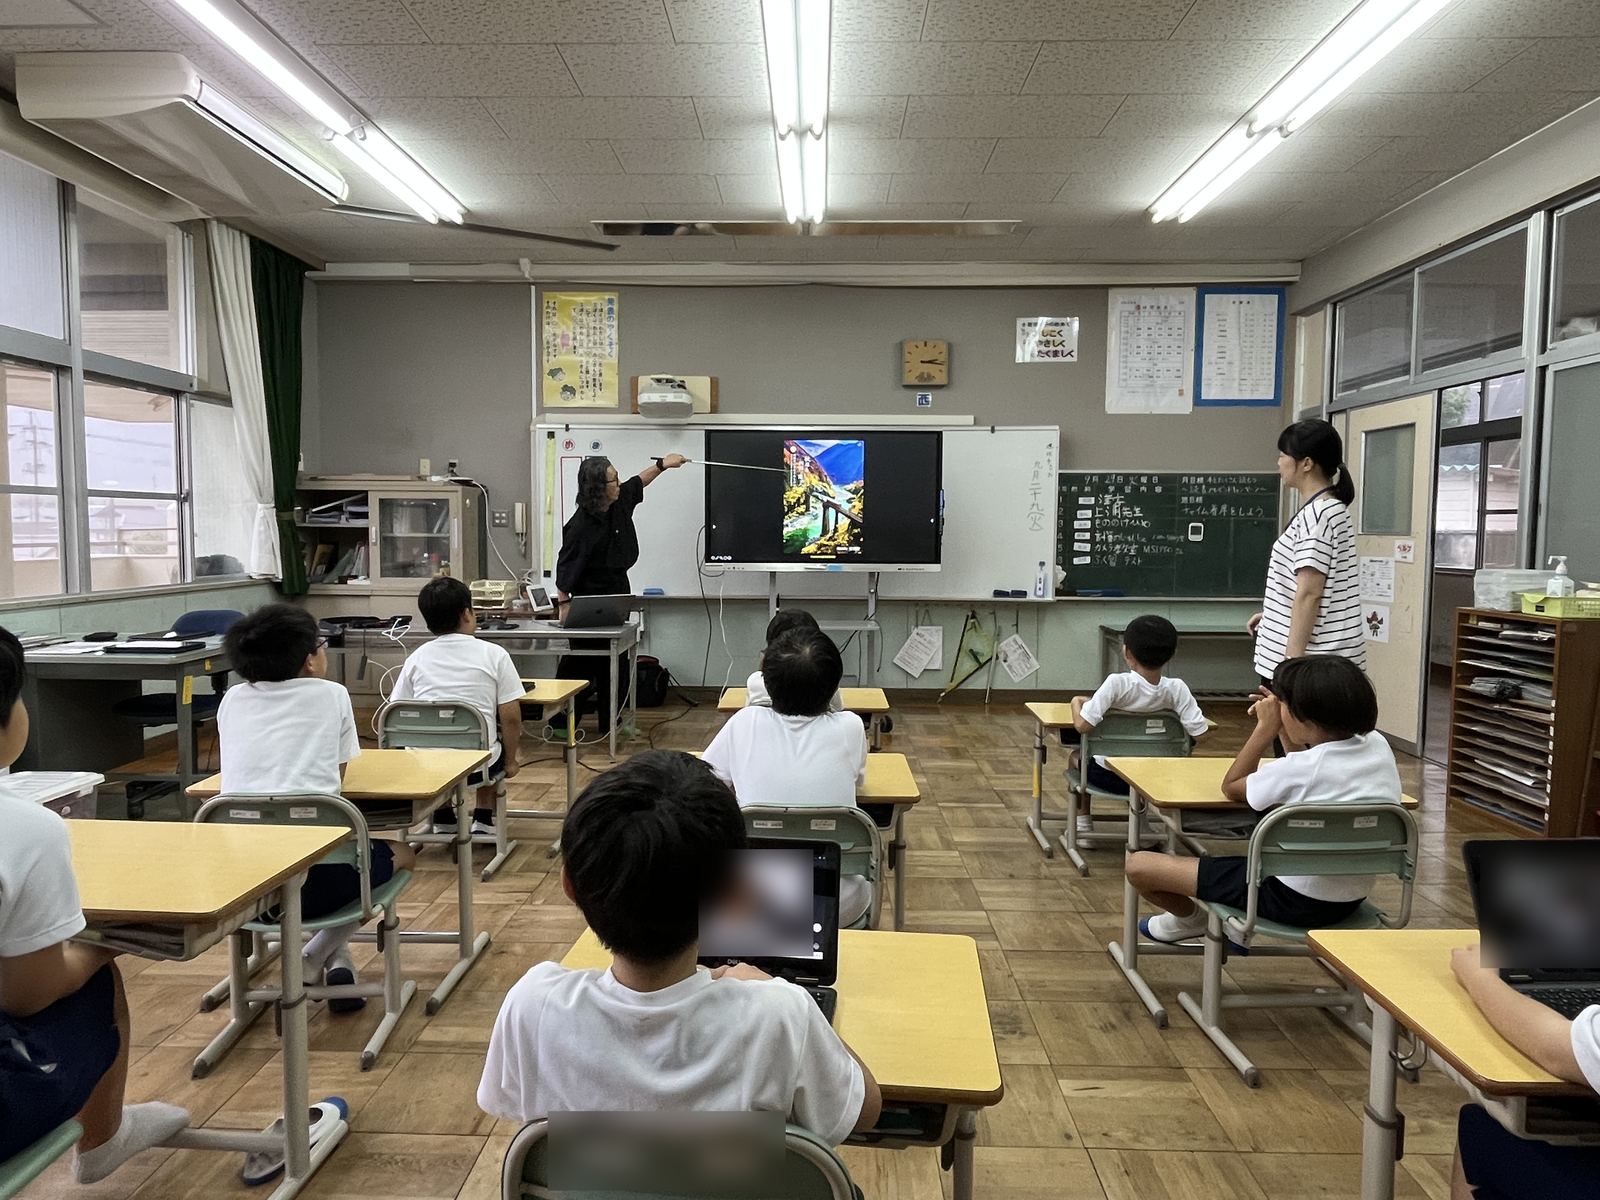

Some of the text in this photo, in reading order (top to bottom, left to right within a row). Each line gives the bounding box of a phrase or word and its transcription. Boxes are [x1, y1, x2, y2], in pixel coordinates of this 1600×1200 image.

[1037, 349, 1074, 358] たくましく
